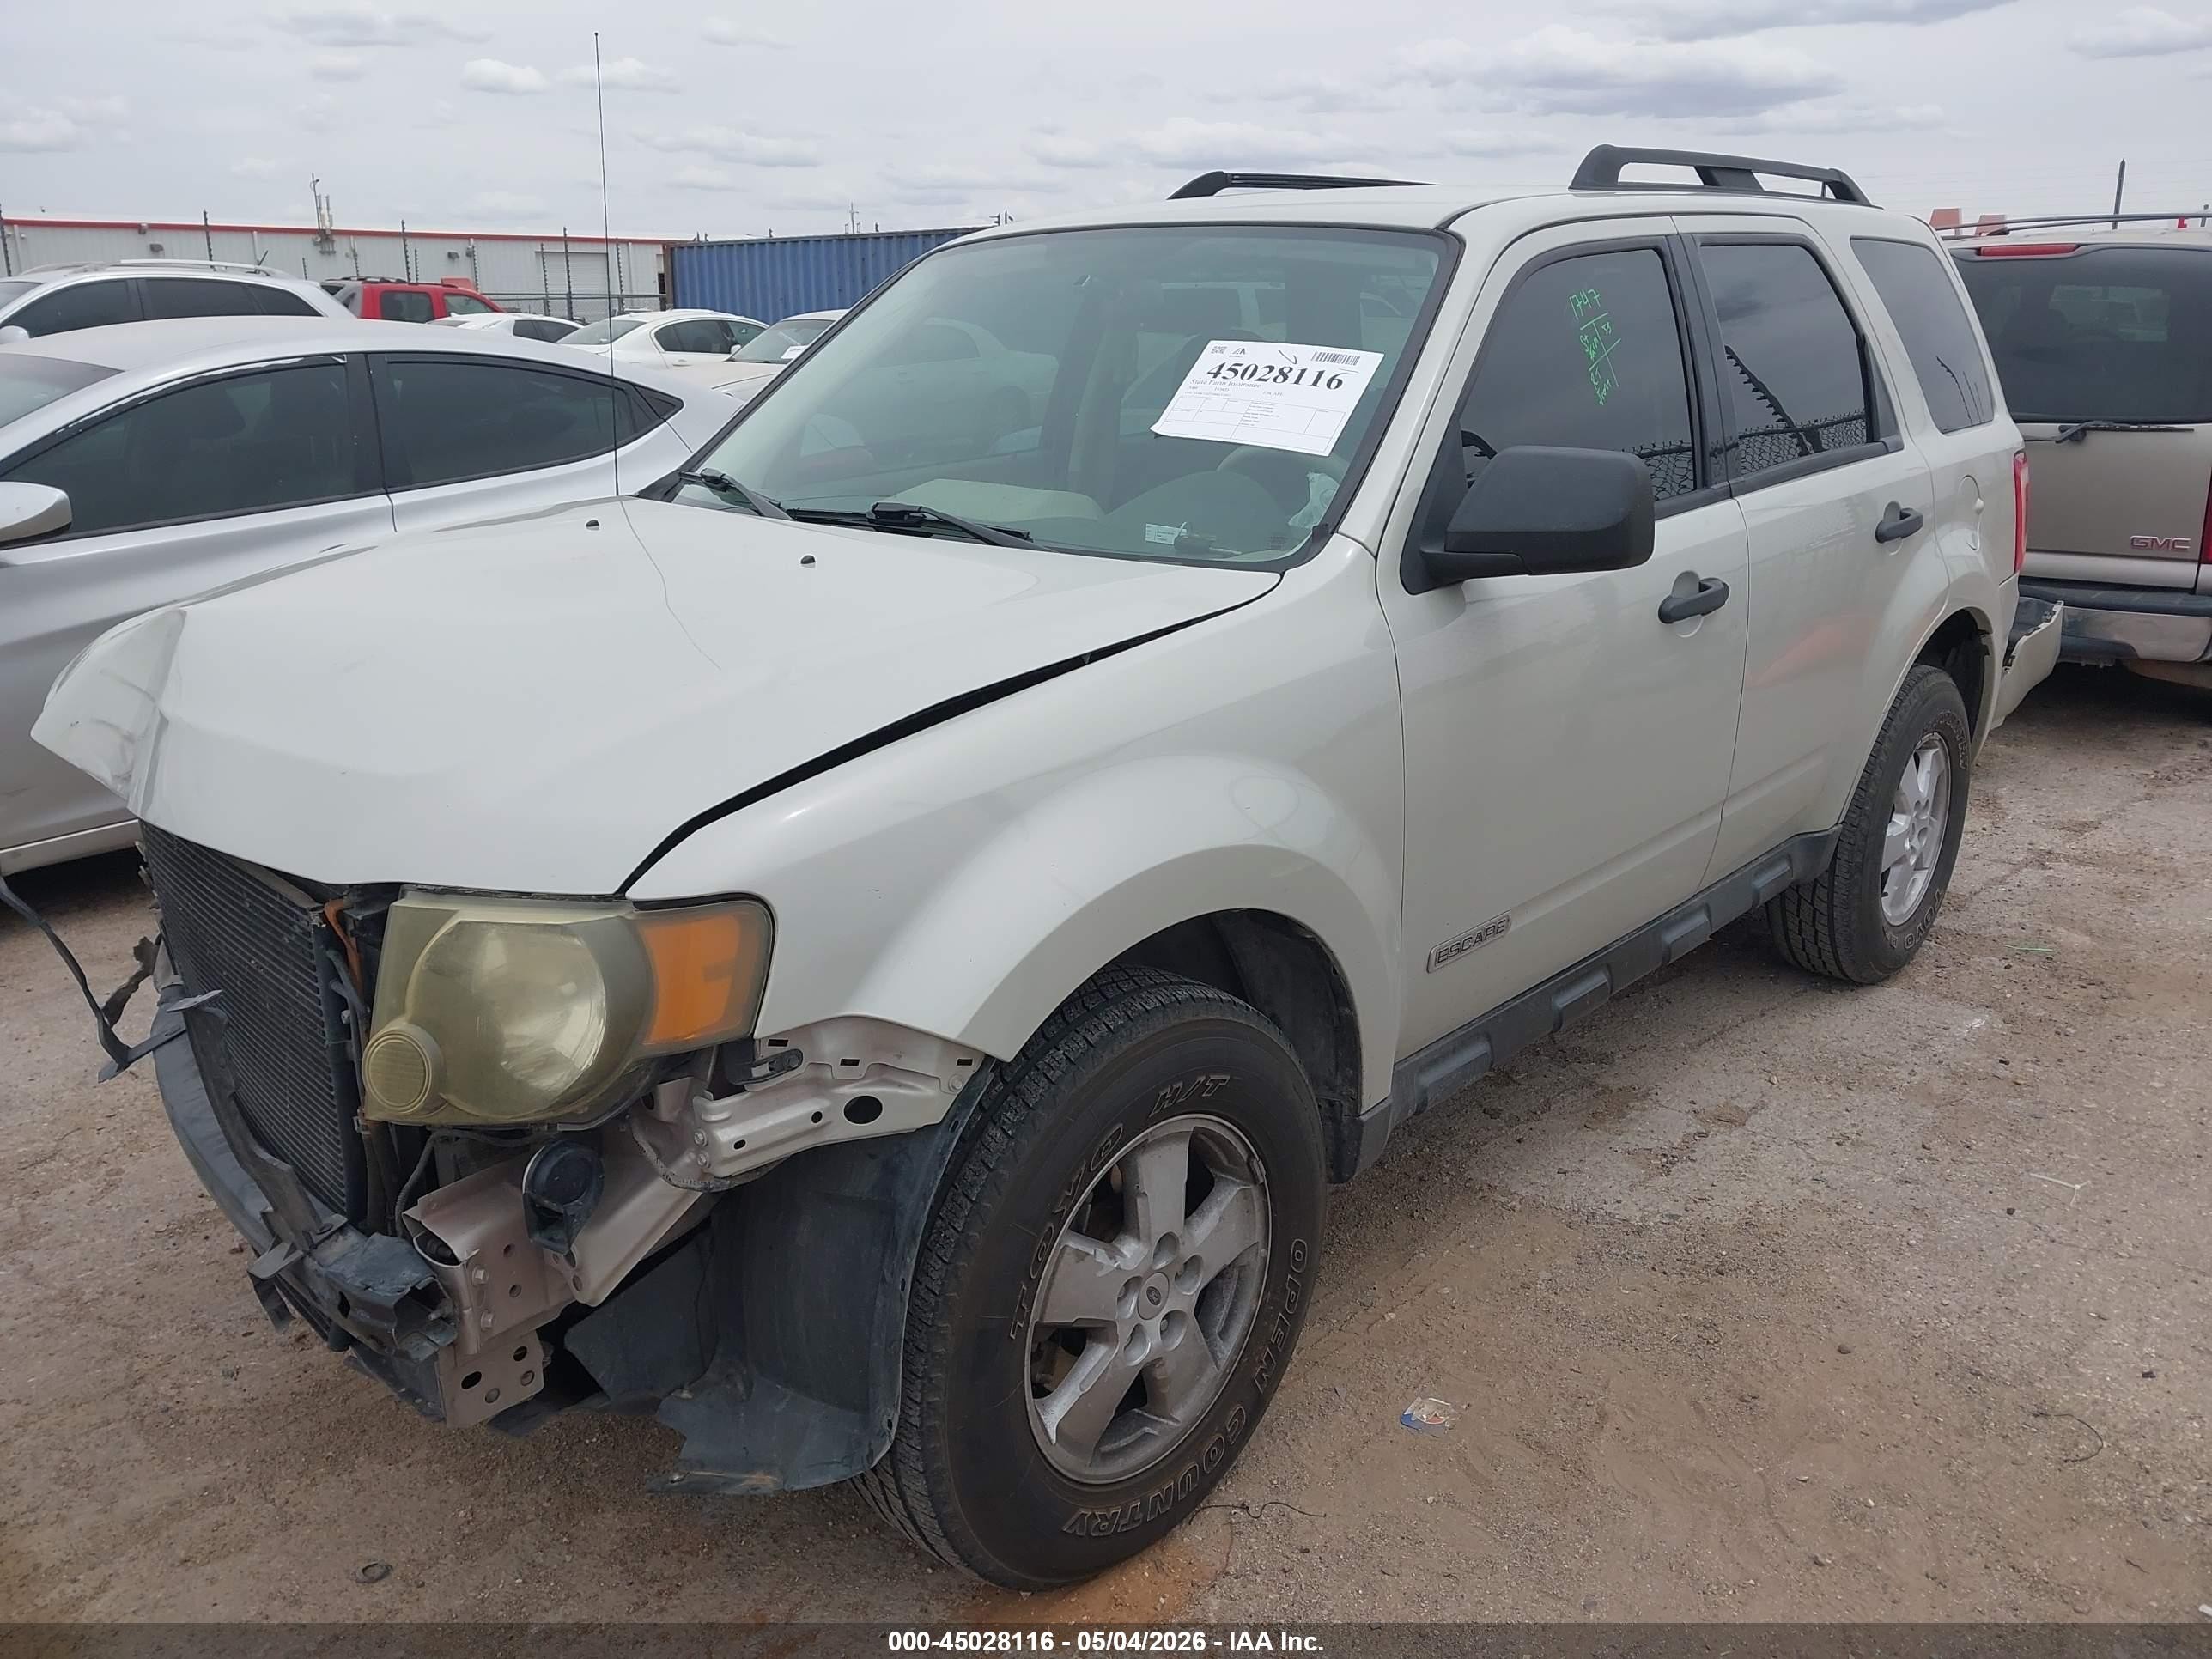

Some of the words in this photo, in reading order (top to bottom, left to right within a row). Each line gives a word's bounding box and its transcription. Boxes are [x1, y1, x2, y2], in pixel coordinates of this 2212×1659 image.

[1569, 289, 1601, 320] 1747
[1206, 362, 1348, 390] 45028116
[2130, 535, 2191, 551] GMC
[1436, 917, 1507, 965] ESCAPE
[1149, 1073, 1231, 1117] H/T
[1010, 1124, 1123, 1340] TOYO
[1253, 1238, 1308, 1395] OPEN
[1060, 1406, 1247, 1537] COUNTRY
